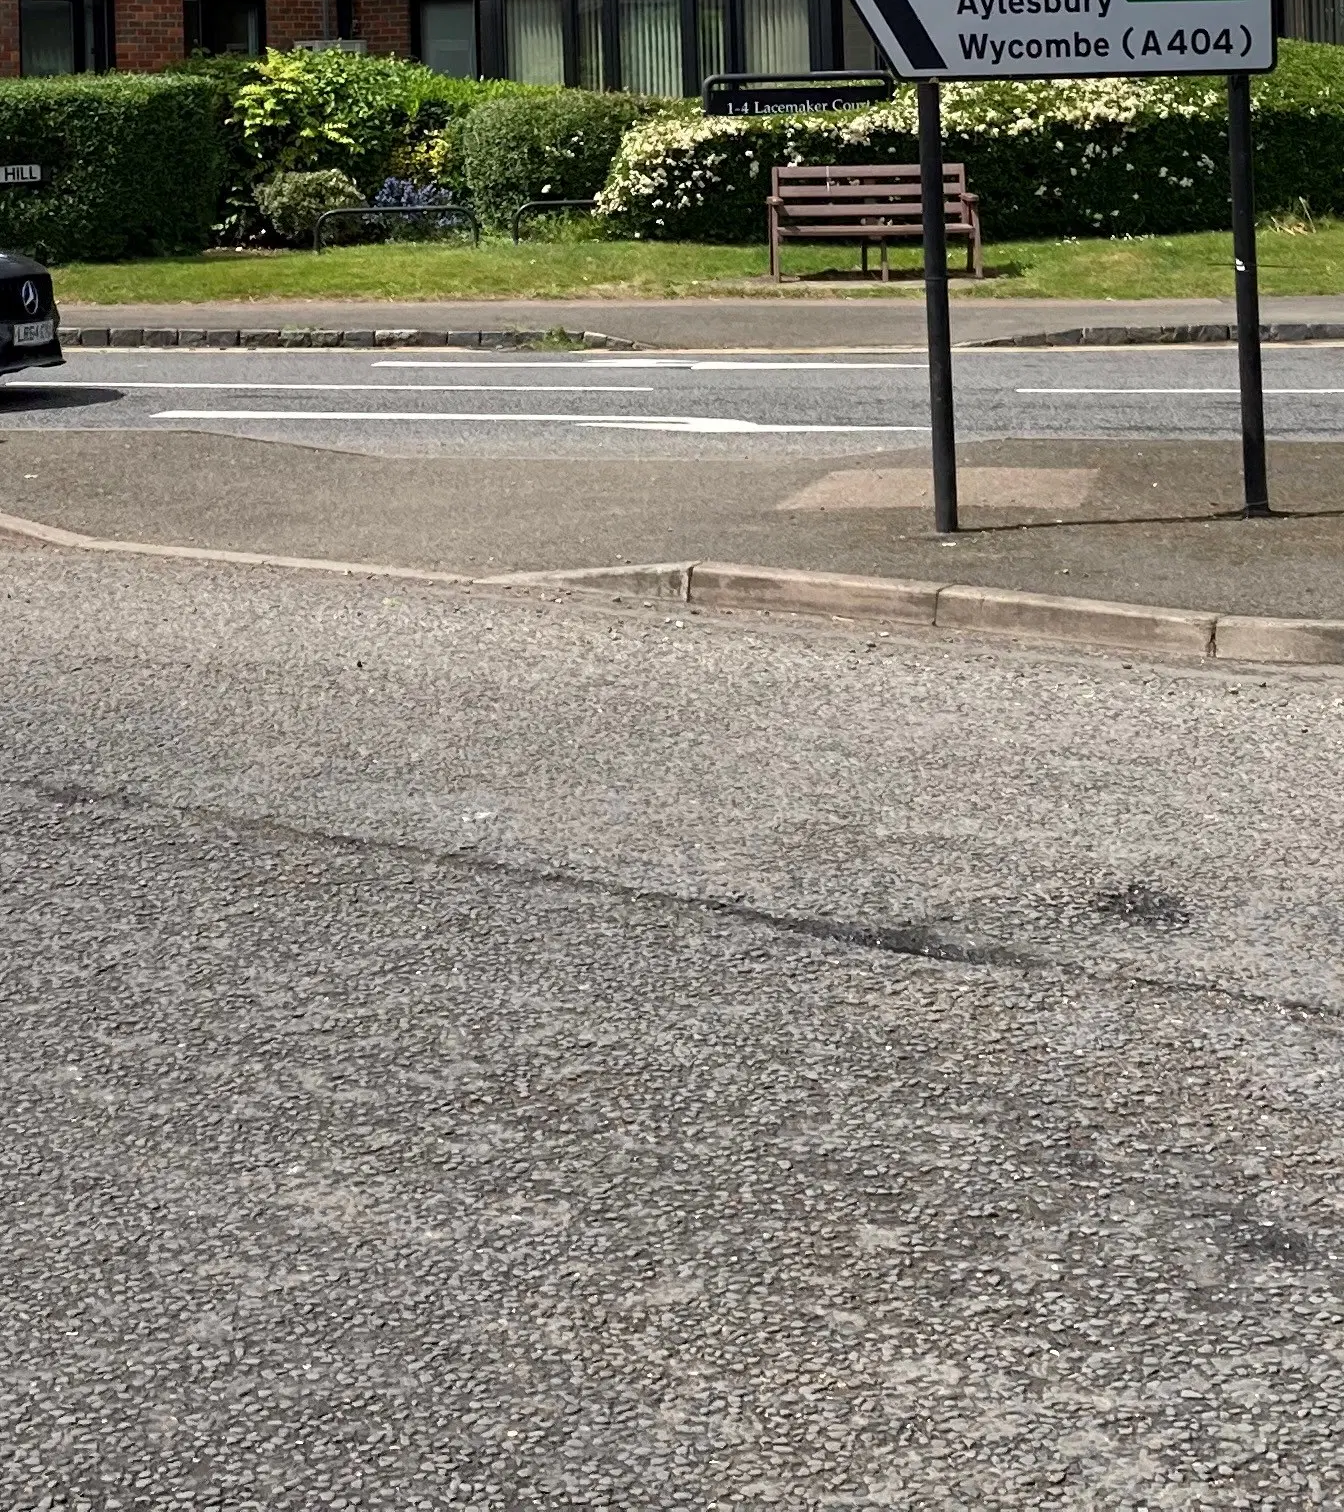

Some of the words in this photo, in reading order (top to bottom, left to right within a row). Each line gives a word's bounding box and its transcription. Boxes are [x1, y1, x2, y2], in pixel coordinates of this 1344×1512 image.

[959, 31, 1111, 65] Wycombe
[1122, 24, 1253, 59] (A404)
[727, 101, 750, 115] 1-4
[754, 100, 828, 114] Lacemaker
[4, 166, 38, 181] HILL
